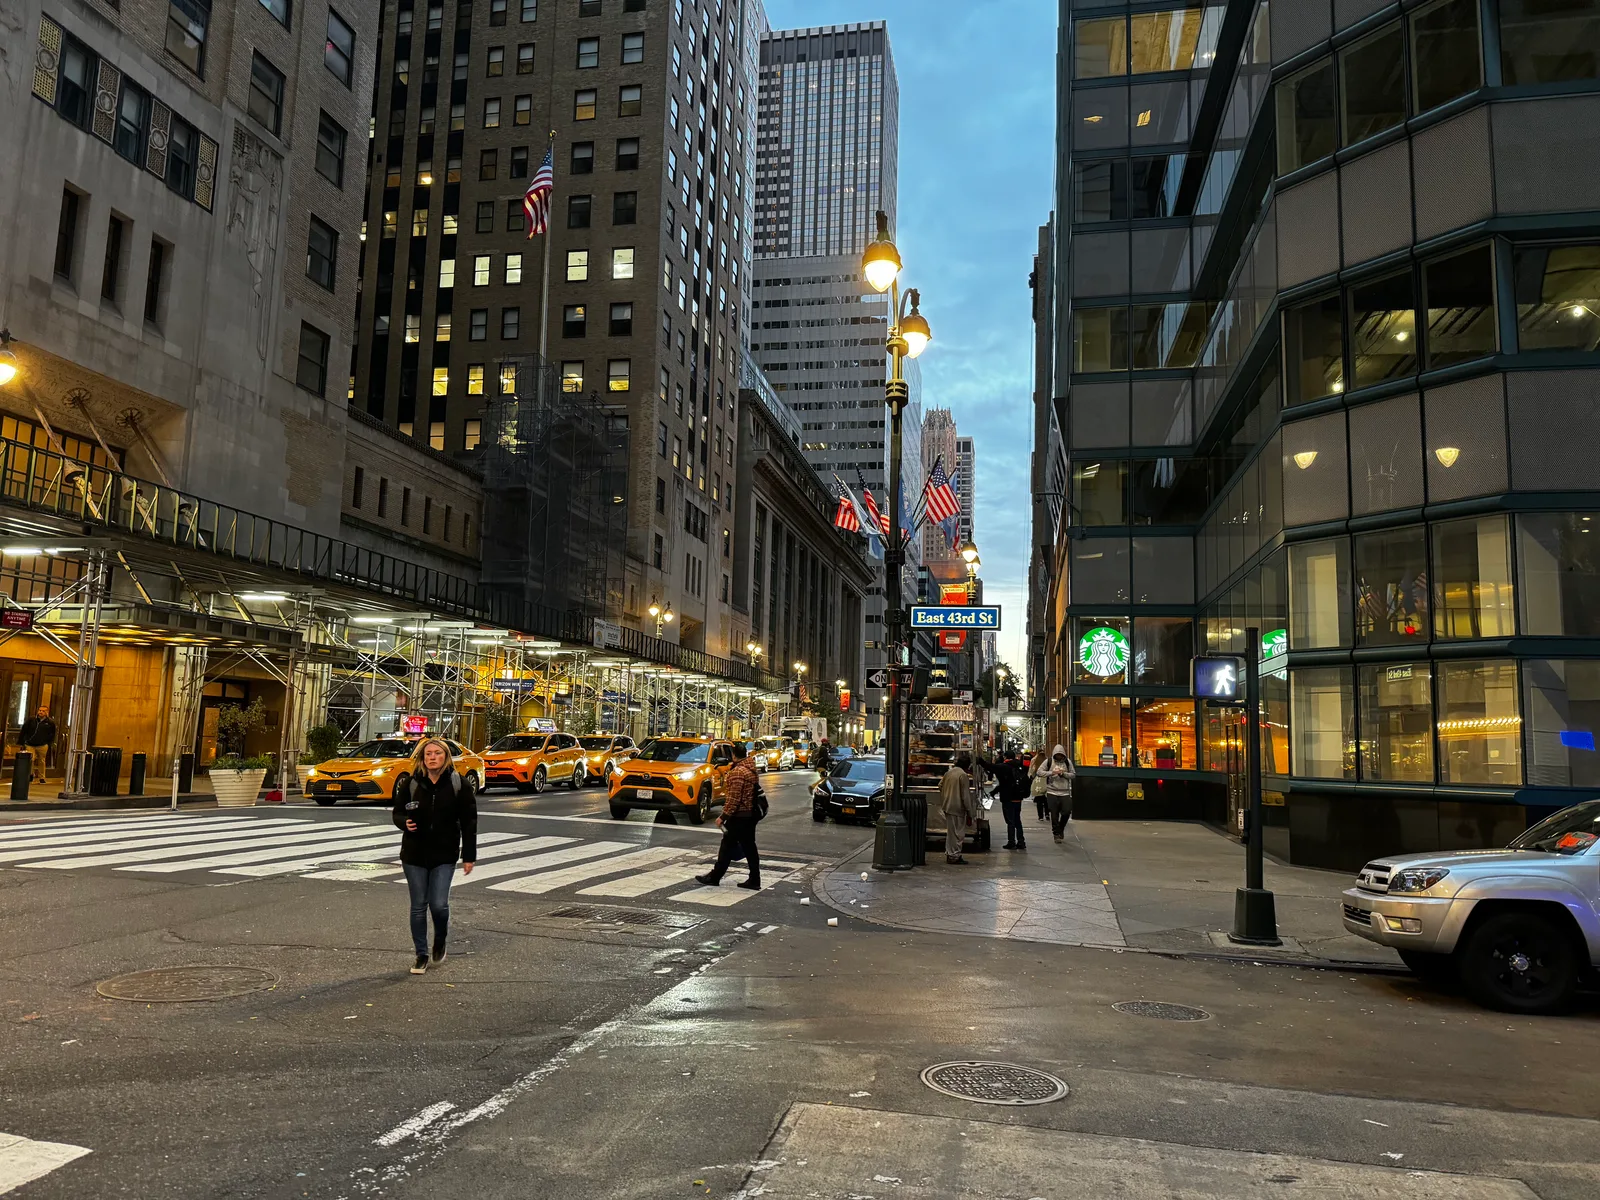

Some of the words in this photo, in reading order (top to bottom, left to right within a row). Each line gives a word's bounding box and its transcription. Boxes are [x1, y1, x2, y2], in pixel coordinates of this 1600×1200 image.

[916, 611, 945, 624] East
[947, 611, 976, 624] 43rd
[978, 611, 993, 624] St
[875, 674, 887, 683] ON
[900, 674, 912, 683] WA
